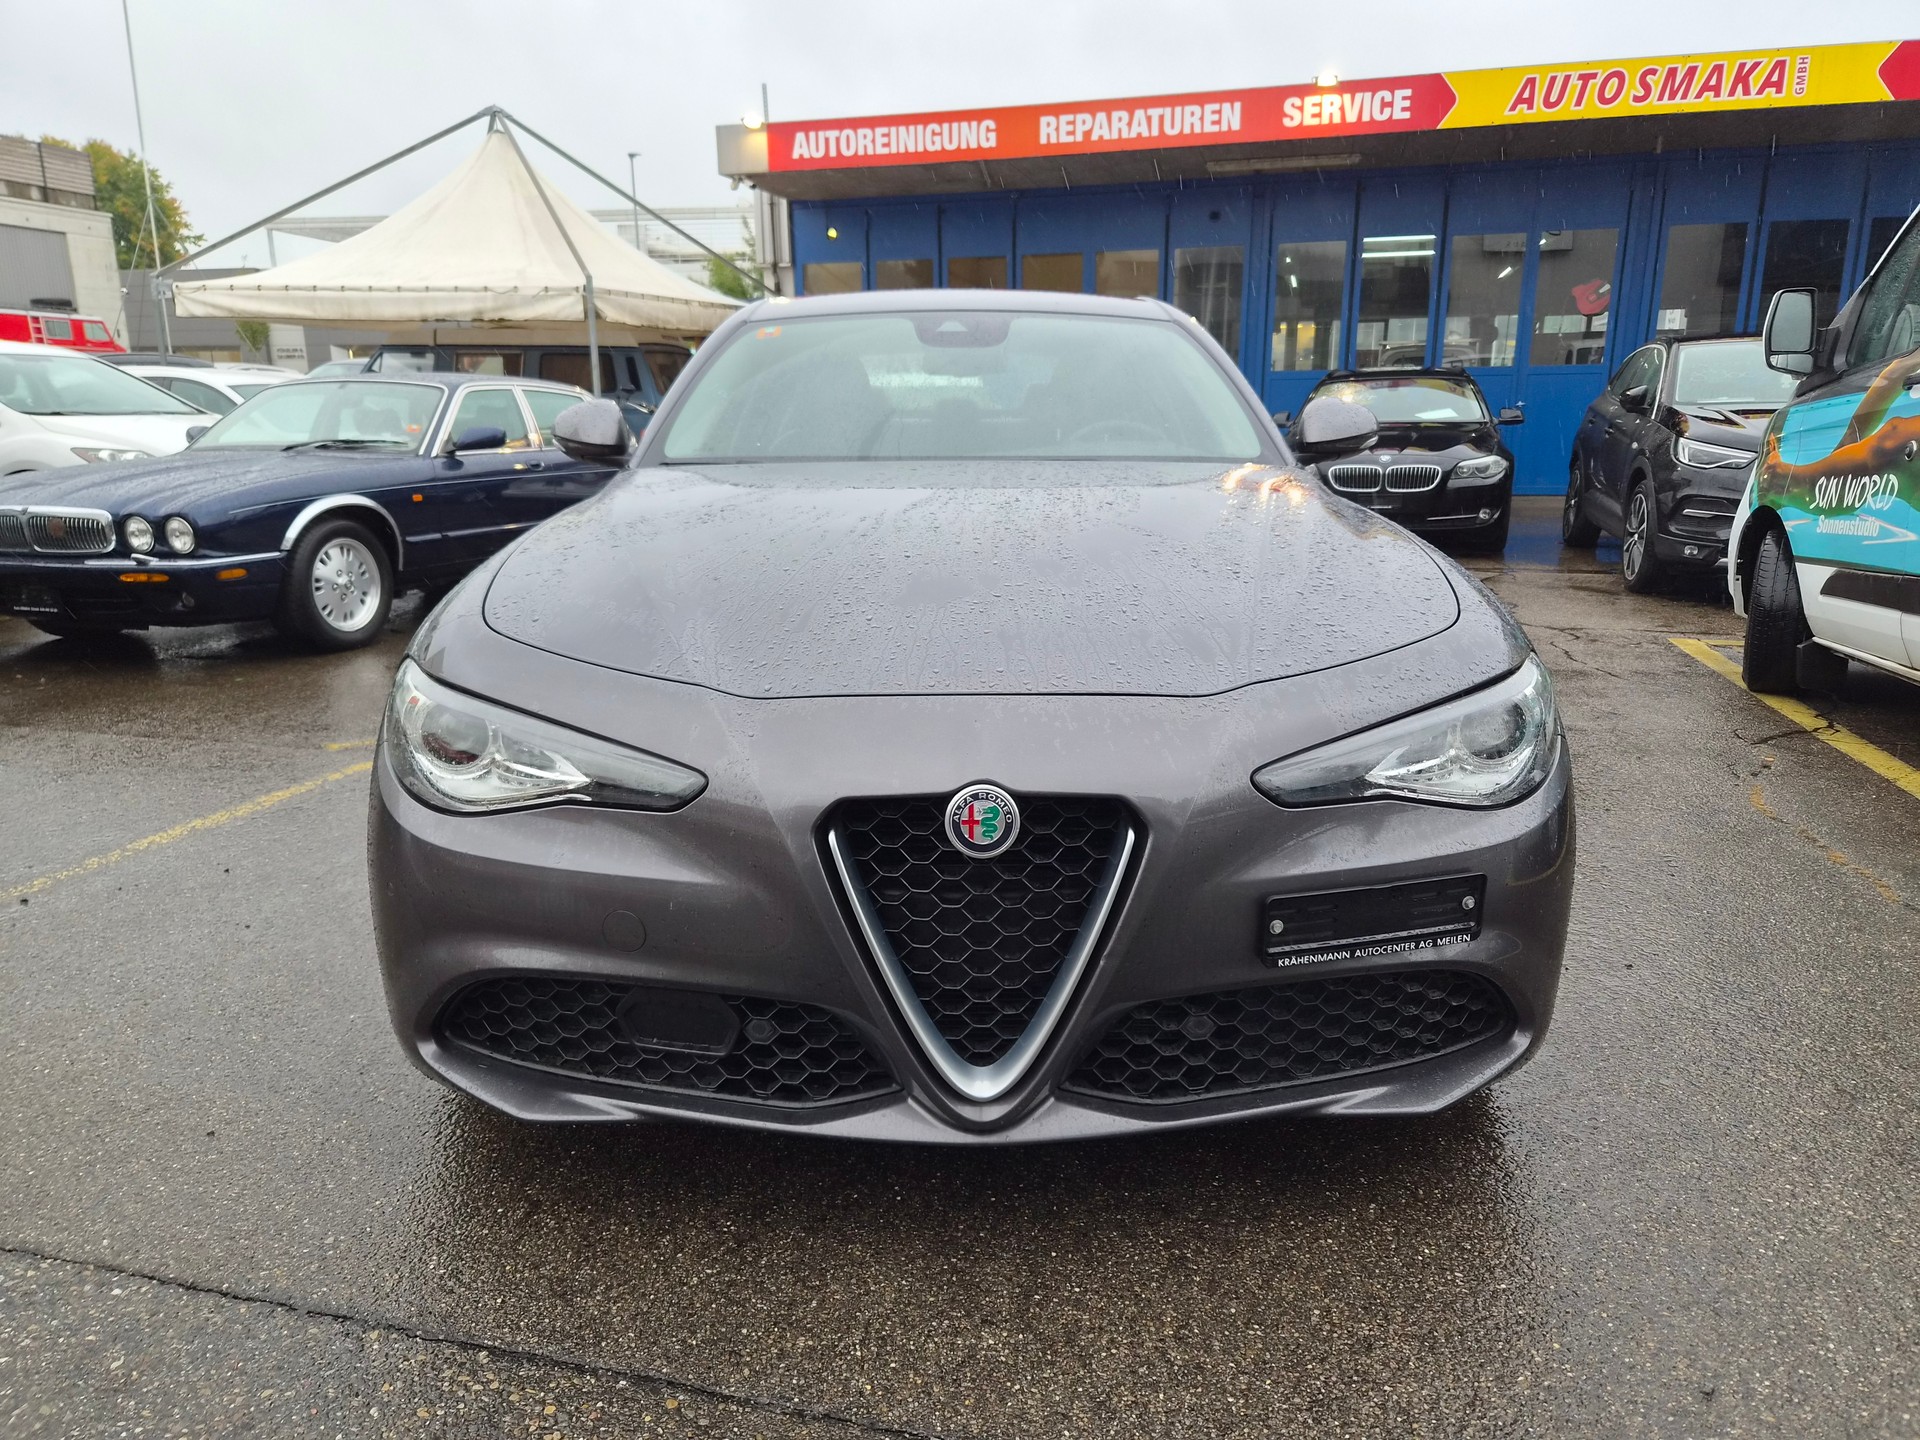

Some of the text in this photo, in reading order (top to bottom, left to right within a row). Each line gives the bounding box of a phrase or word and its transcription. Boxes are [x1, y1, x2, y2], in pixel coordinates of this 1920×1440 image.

[1506, 58, 1789, 113] AUTO SMAKA
[1794, 55, 1810, 96] GMBH
[1038, 101, 1242, 146] REPARATUREN
[1281, 88, 1413, 128] SERVICE
[791, 119, 997, 160] AUTOREINIGUNG
[1809, 473, 1899, 511] SUN WORLD
[1816, 514, 1880, 537] Sonnenstudio
[953, 793, 1012, 822] ALFA ROMEO
[1278, 934, 1471, 967] KRÄHENMANN AUTOCENTER AG MEILEN
